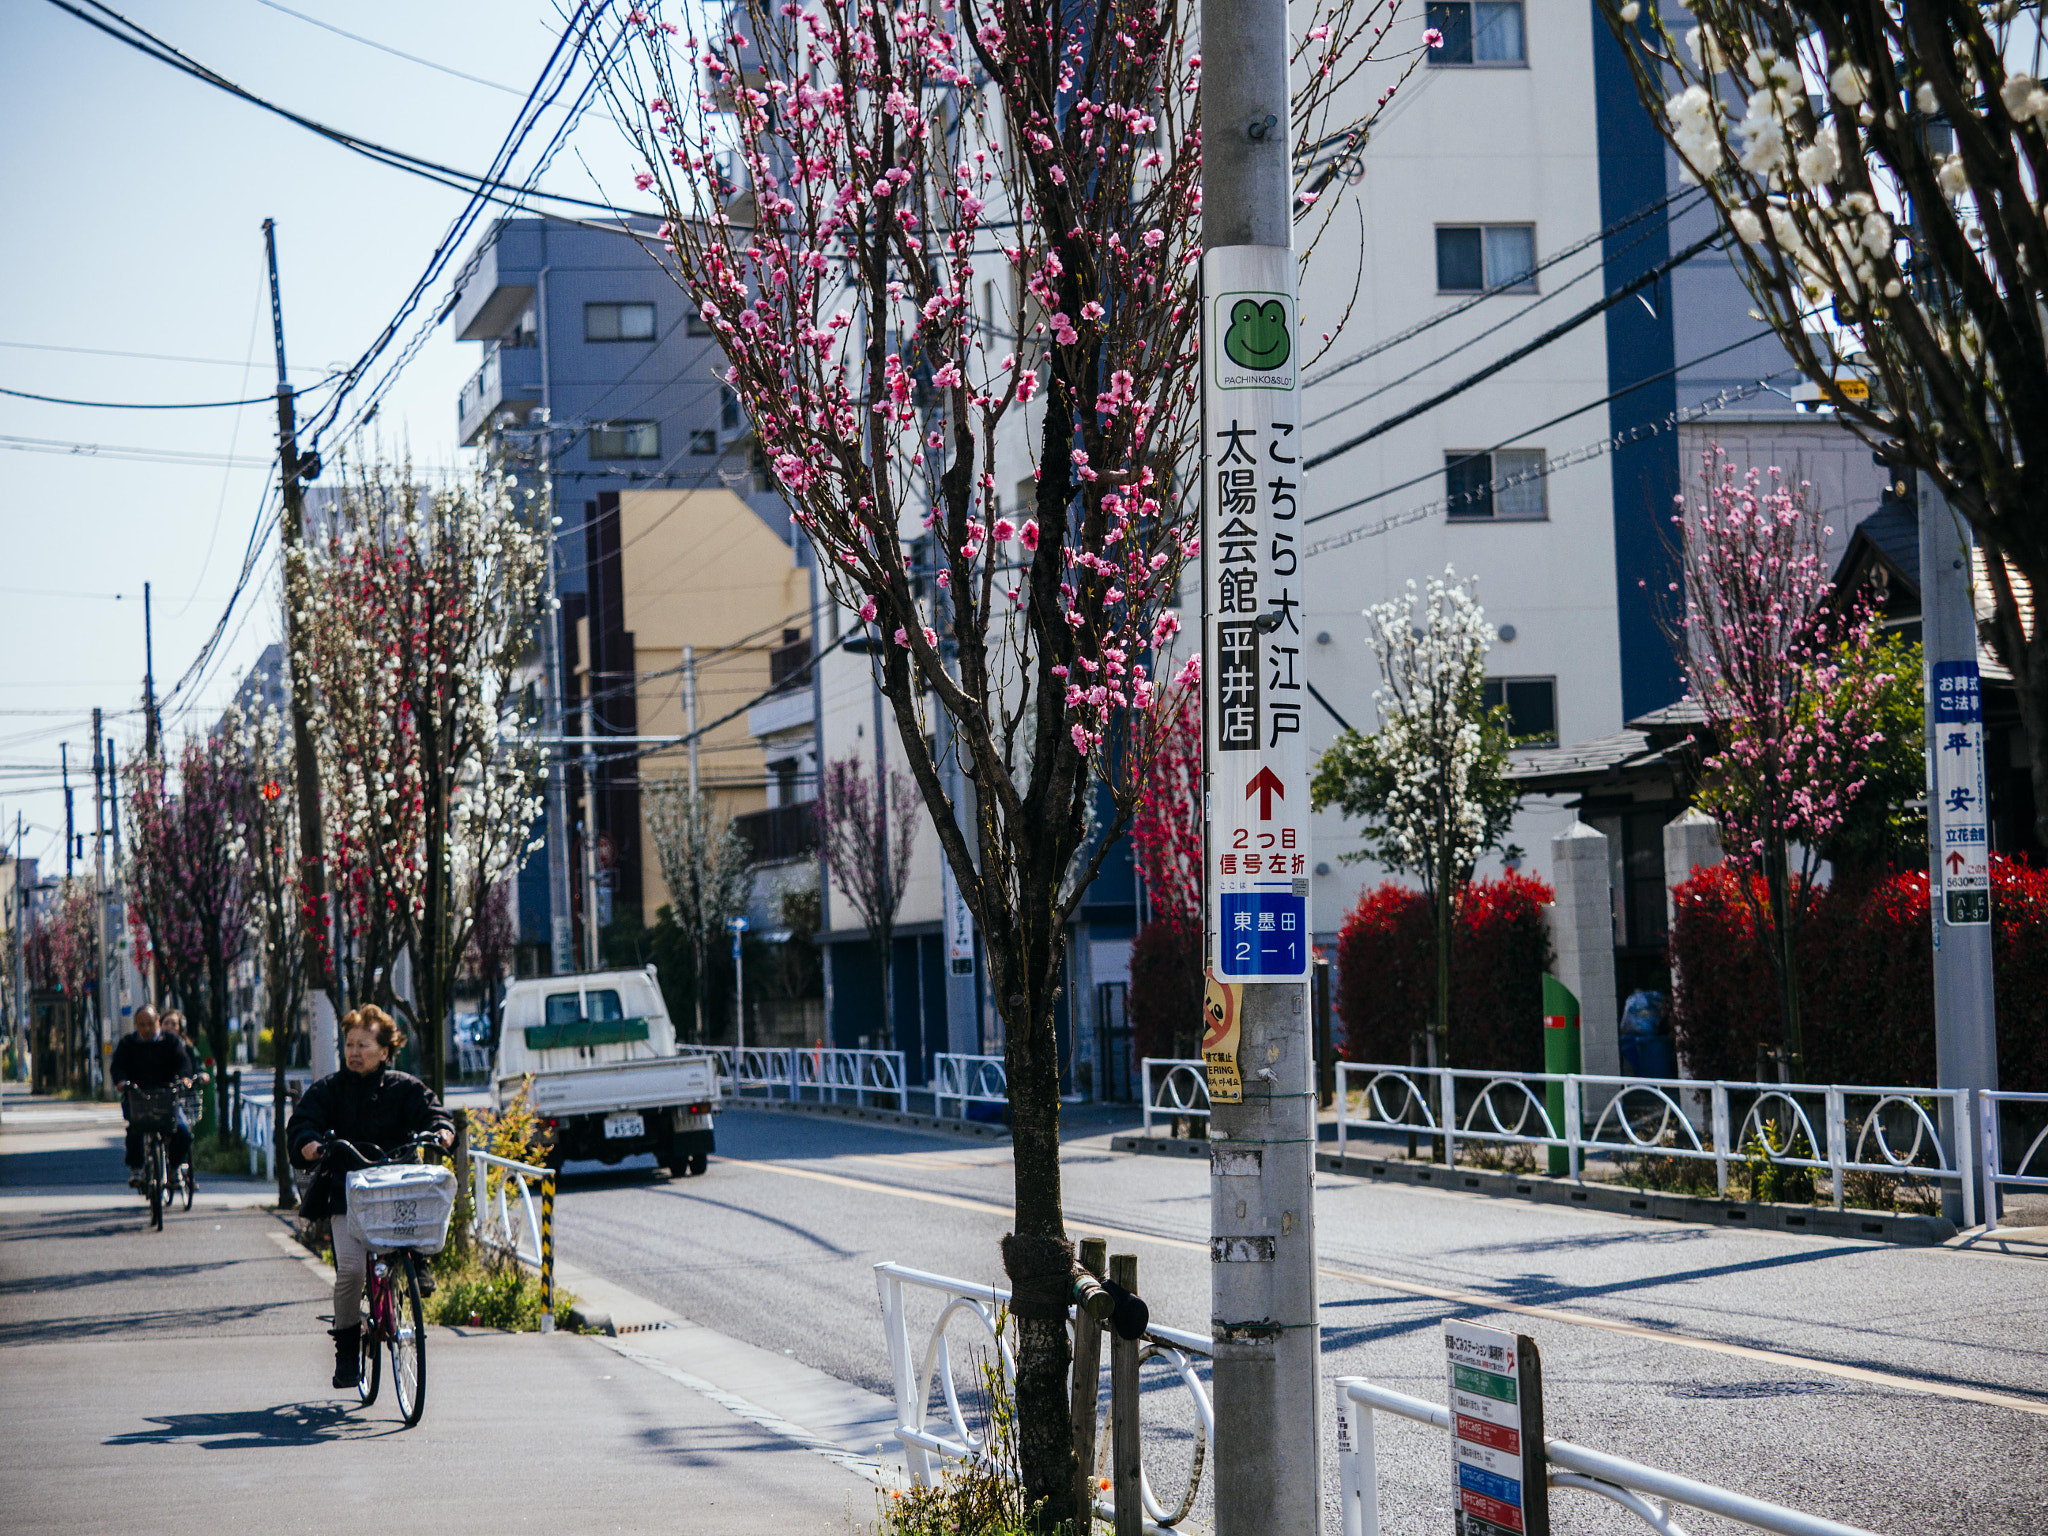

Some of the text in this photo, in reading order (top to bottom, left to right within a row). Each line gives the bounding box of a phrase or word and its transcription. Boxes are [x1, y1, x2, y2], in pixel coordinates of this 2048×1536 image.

[1224, 375, 1292, 387] PACHINKO&SLOT
[1217, 419, 1258, 743] 太陽会館 平井店
[1268, 422, 1301, 749] こちら大江戸
[1939, 676, 1978, 692] お葬式
[1940, 695, 1979, 711] ご法事
[1943, 732, 1976, 812] 平安
[1233, 828, 1296, 849] 2つ目
[1220, 853, 1305, 875] 信号左折
[1233, 911, 1296, 932] 東墨田
[1957, 909, 1984, 919] 3-37
[1208, 1066, 1234, 1075] ERING
